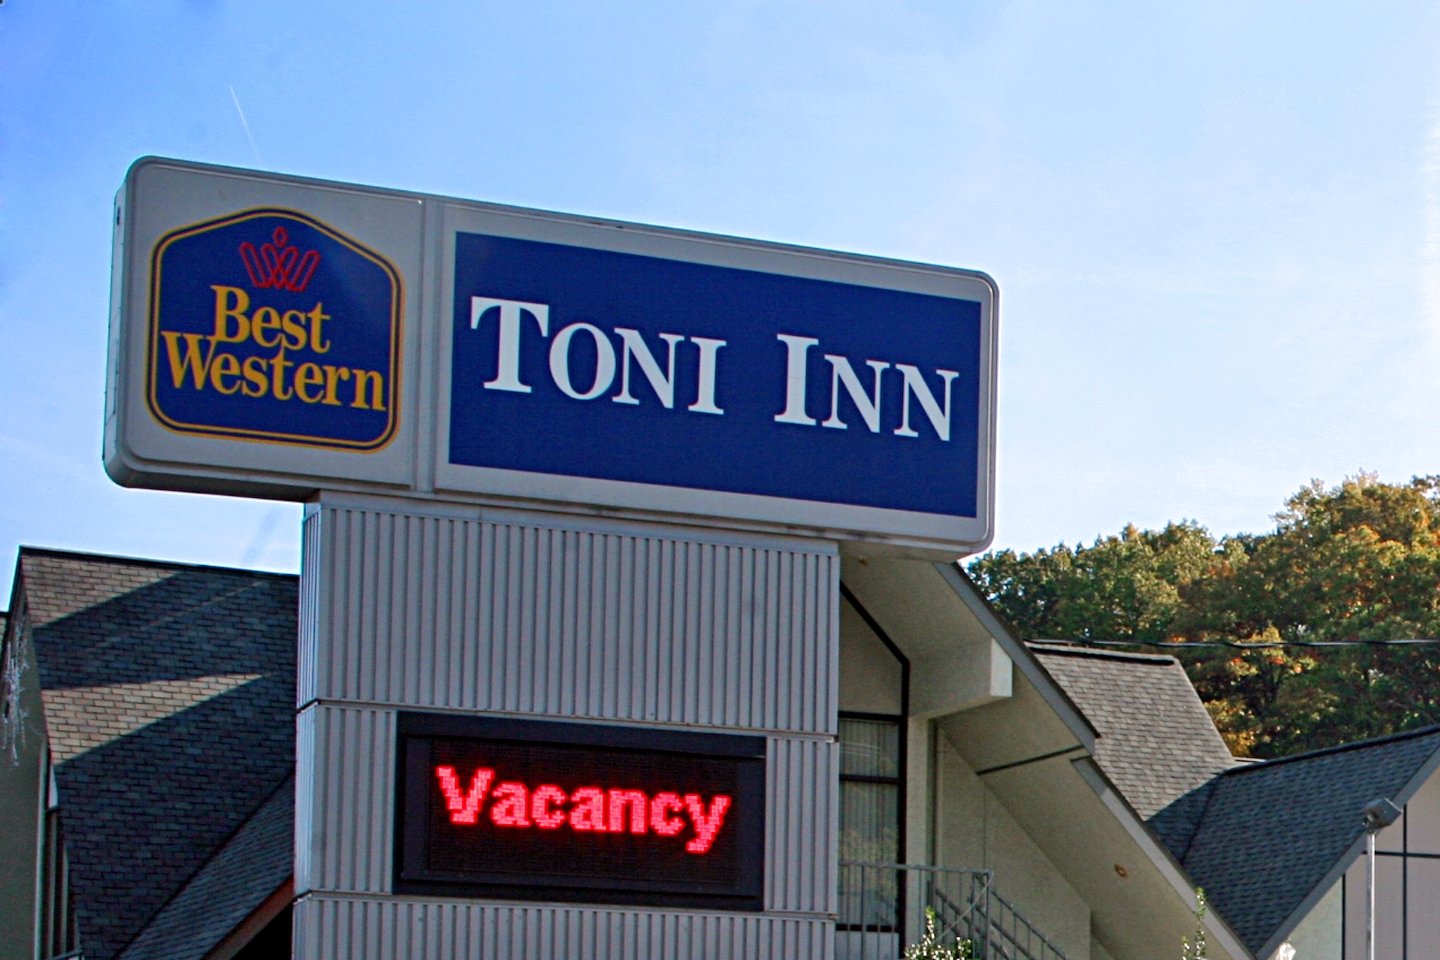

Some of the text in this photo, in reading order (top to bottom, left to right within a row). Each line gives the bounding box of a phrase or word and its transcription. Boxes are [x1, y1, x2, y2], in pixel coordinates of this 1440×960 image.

[210, 284, 331, 354] Best
[160, 330, 387, 411] Western
[470, 296, 960, 442] TONI INN
[435, 765, 732, 854] Vacancy
